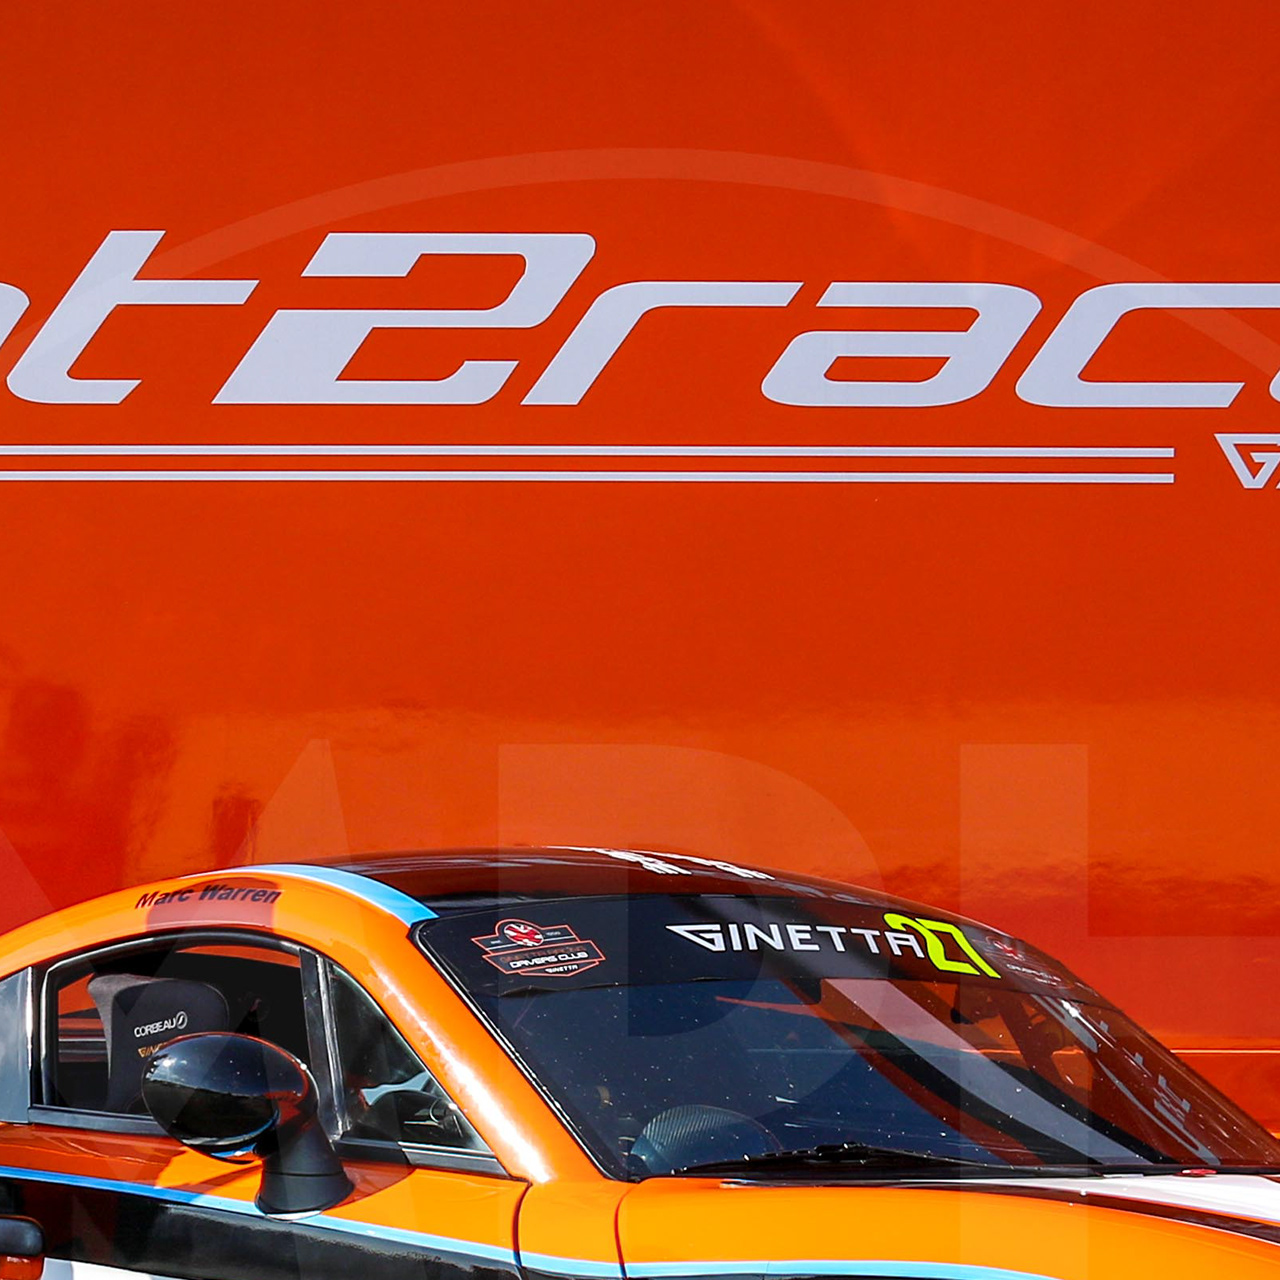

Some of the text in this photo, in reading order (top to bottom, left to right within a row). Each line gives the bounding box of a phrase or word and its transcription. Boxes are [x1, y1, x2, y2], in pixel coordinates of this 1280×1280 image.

[134, 884, 282, 909] Marc Warren
[665, 922, 925, 959] GINETTA
[883, 912, 1002, 979] 27
[509, 951, 589, 969] DRIVERS CLUB
[134, 1017, 176, 1038] CORBEAU
